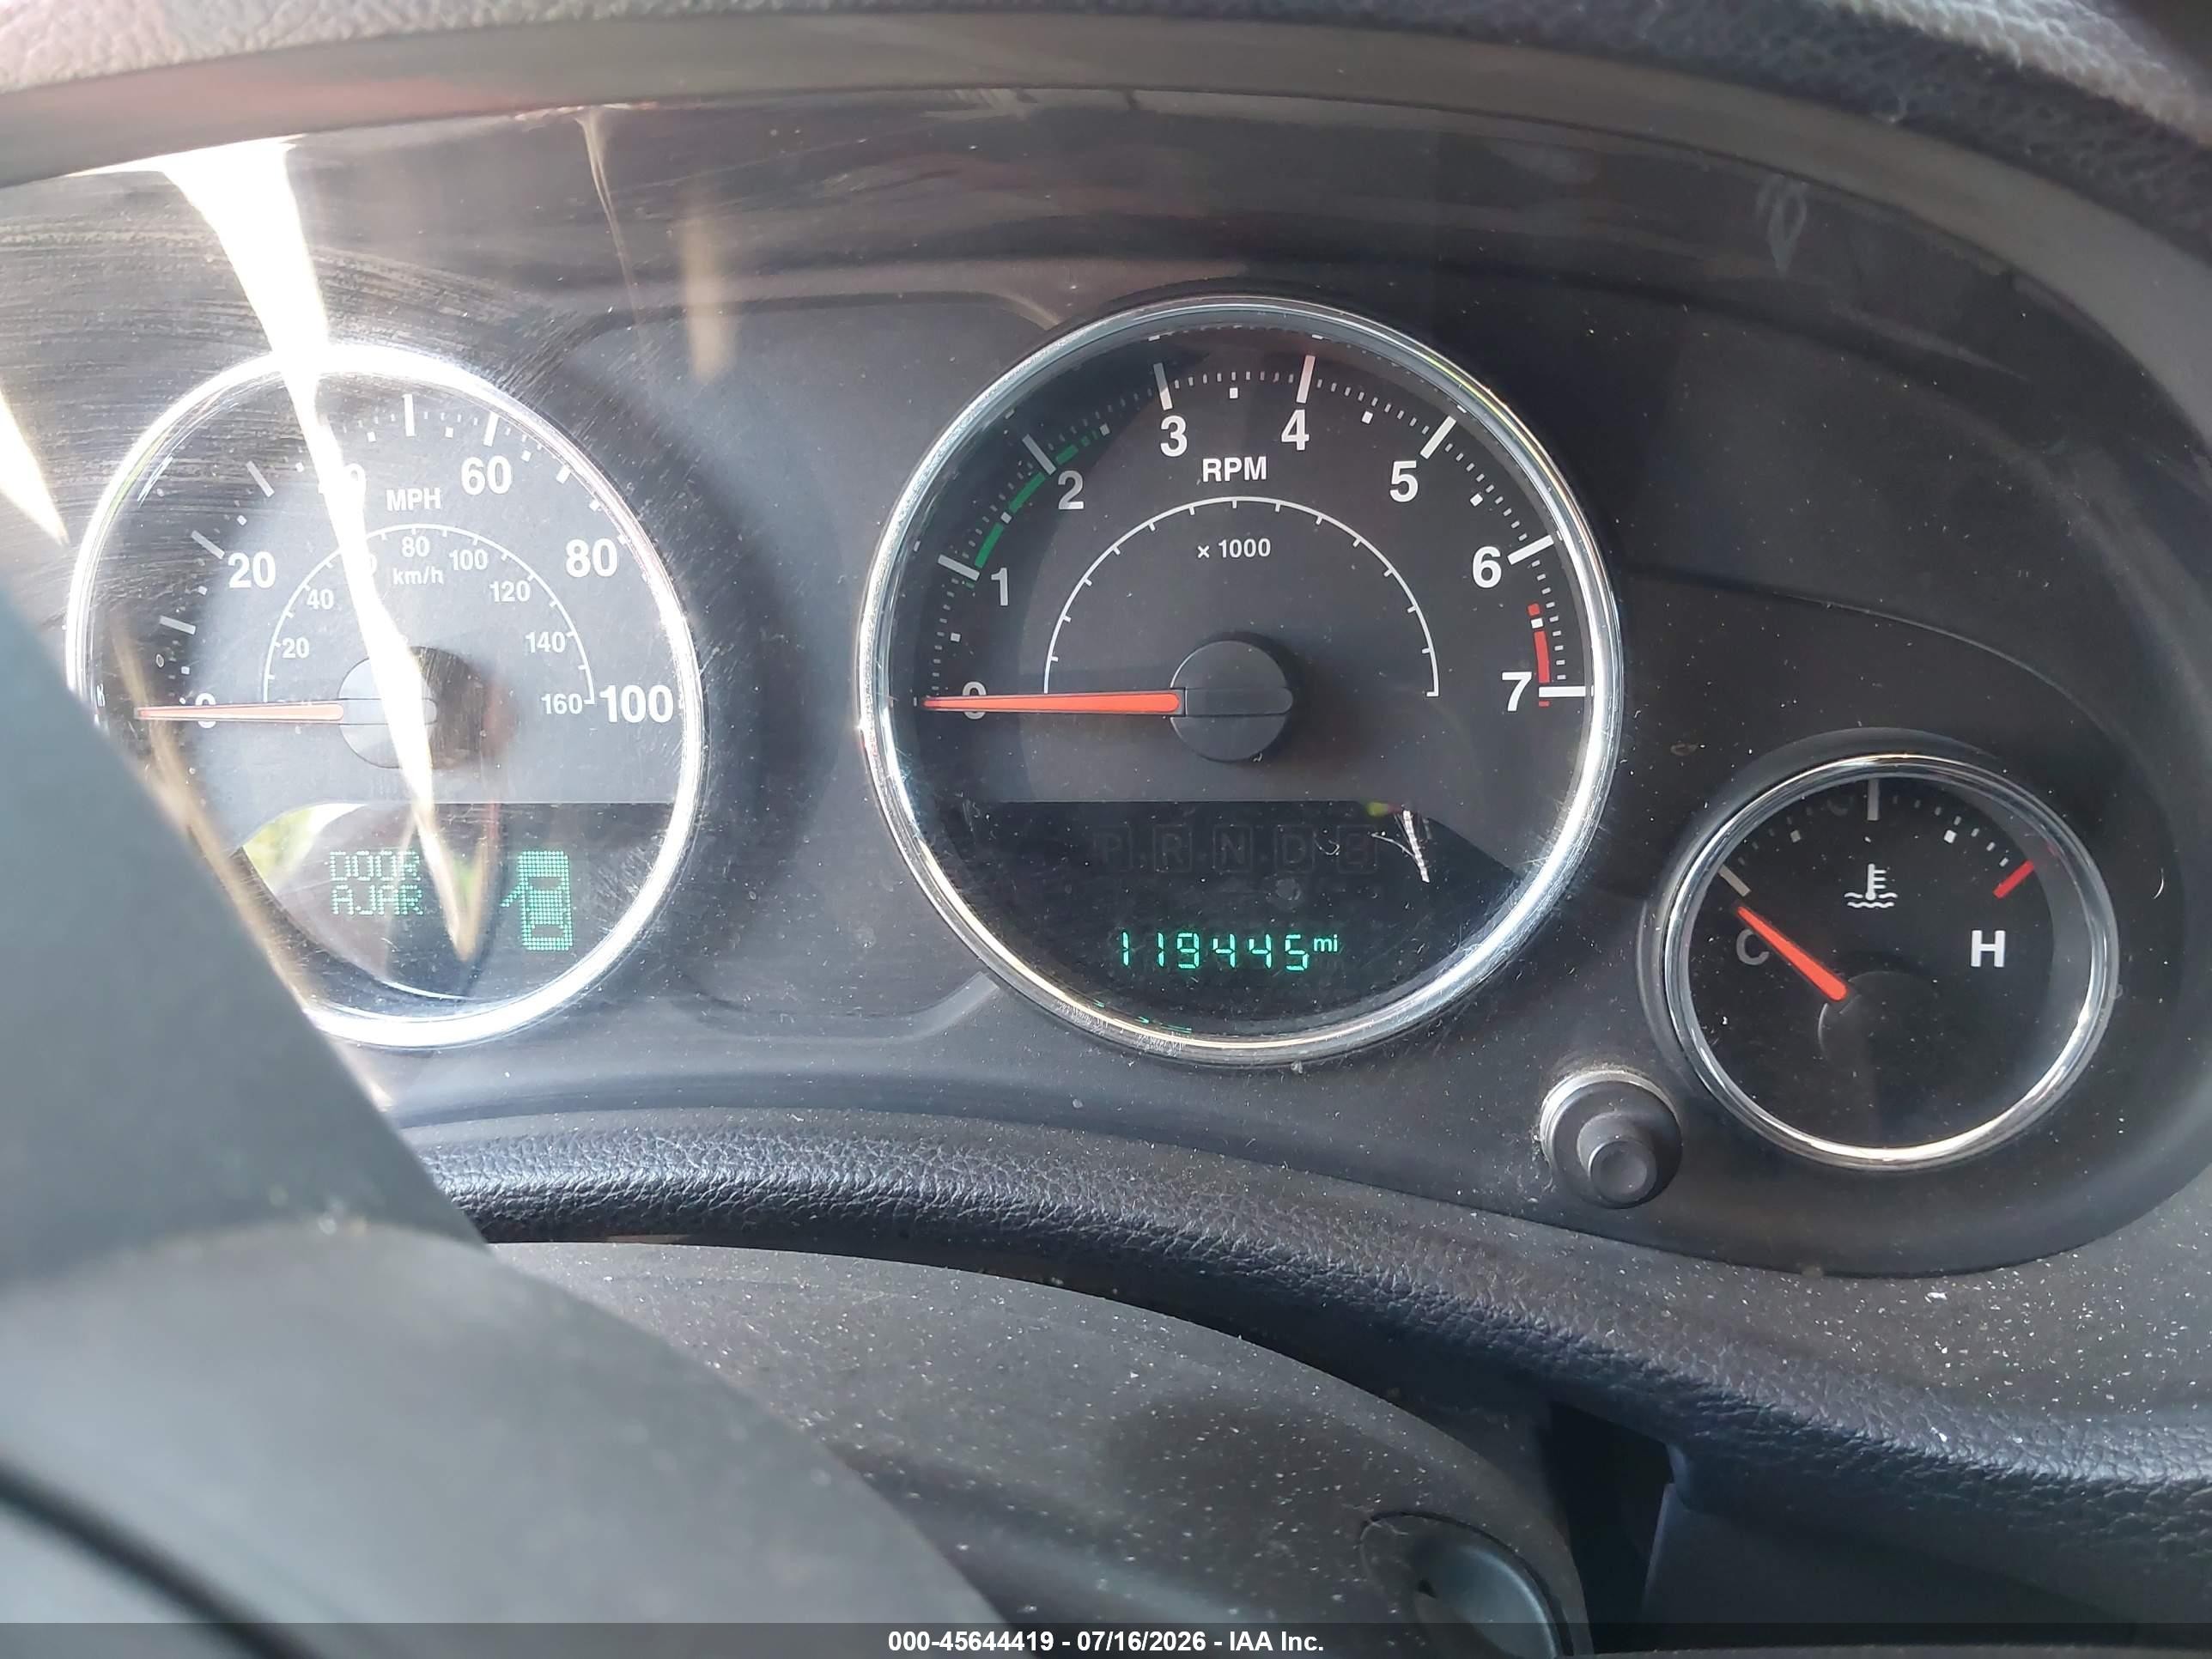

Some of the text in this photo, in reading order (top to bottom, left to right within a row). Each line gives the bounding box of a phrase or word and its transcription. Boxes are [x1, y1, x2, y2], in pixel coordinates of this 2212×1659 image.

[1161, 416, 1188, 458] 3
[1281, 410, 1310, 451] 4
[461, 456, 512, 495] 60
[1203, 459, 1268, 482] RPM
[1390, 460, 1419, 502] 5
[386, 488, 441, 512] MPH
[1058, 471, 1085, 510] 2
[402, 535, 429, 558] 80
[449, 548, 489, 572] 100
[566, 539, 617, 578] 80
[1218, 538, 1272, 559] 1000
[228, 552, 276, 588] 20
[393, 566, 444, 585] km/h
[1472, 546, 1503, 588] 6
[307, 588, 334, 610] 40
[490, 580, 531, 603] 120
[991, 568, 1008, 605] 1
[283, 636, 310, 659] 20
[525, 631, 566, 653] 140
[542, 693, 583, 716] 160
[600, 684, 673, 723] 100
[1503, 672, 1533, 712] 7
[330, 851, 421, 881] DOOR
[331, 885, 423, 915] AJAR
[1121, 932, 1338, 971] 119445 mi
[1736, 930, 1769, 965] C
[1971, 930, 2005, 968] H
